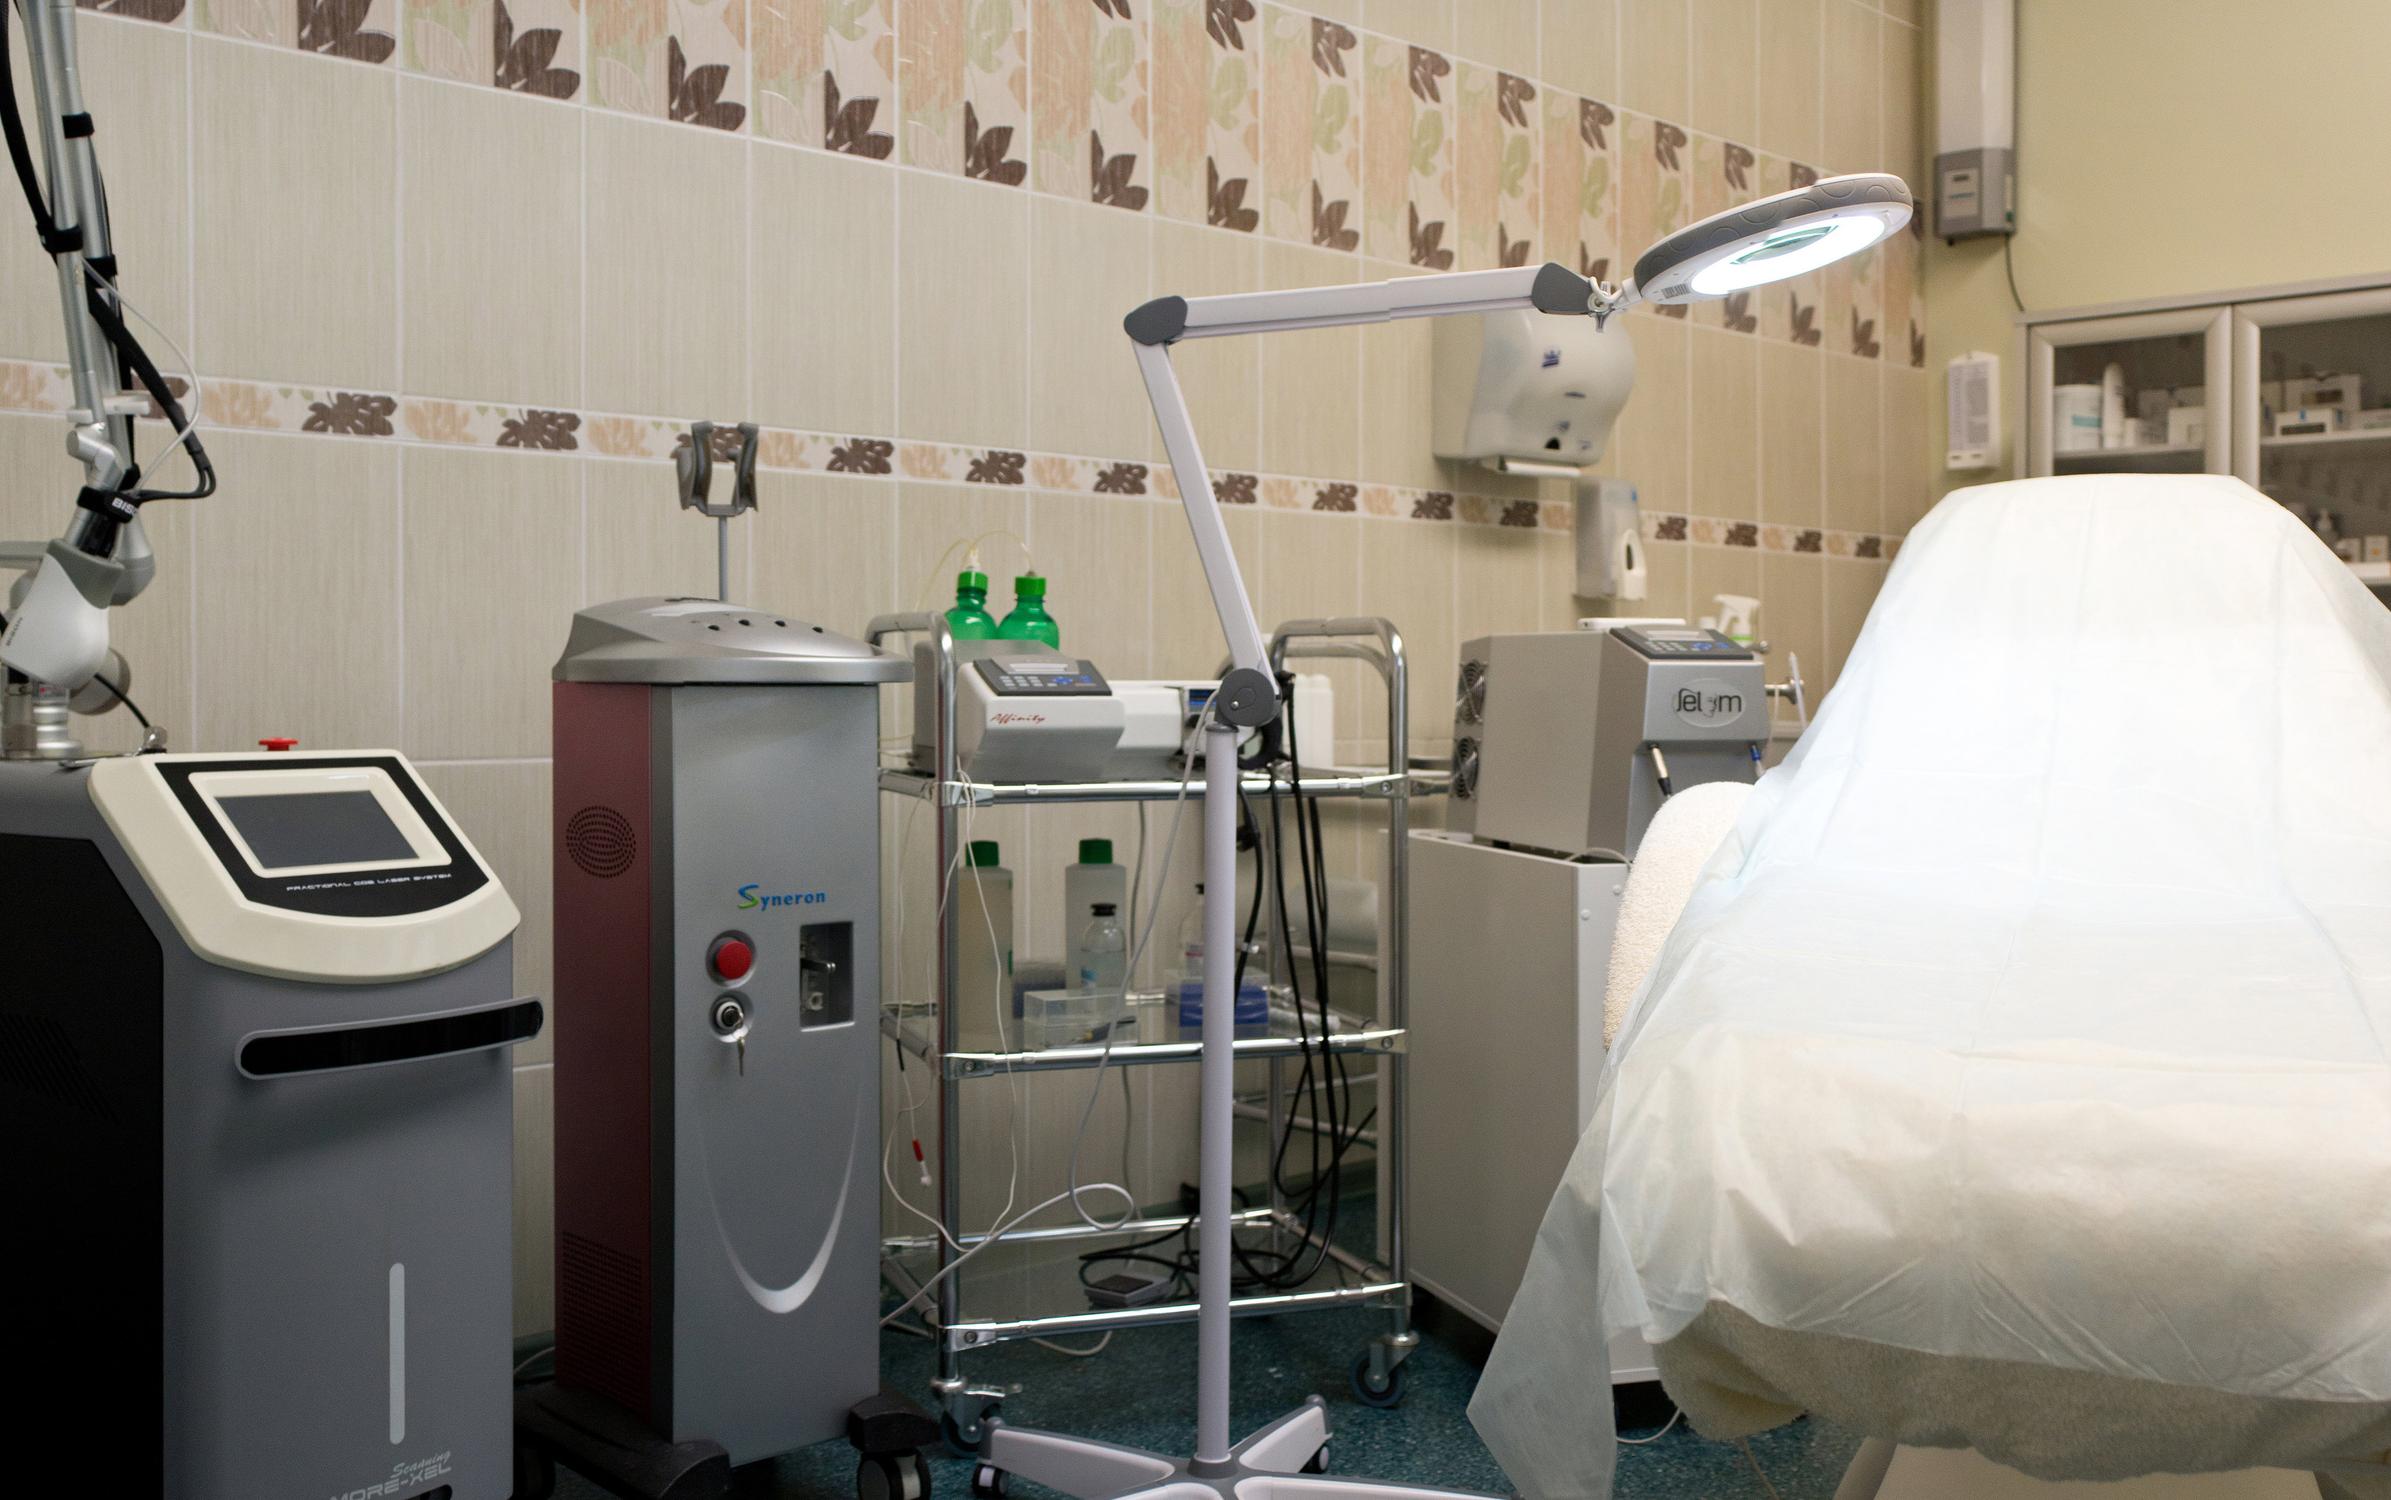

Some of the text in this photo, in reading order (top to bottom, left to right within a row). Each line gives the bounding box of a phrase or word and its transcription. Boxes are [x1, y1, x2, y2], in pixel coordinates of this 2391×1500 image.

[990, 713, 1046, 725] Affinity
[737, 883, 826, 911] Syneron
[390, 1450, 451, 1478] Scanning
